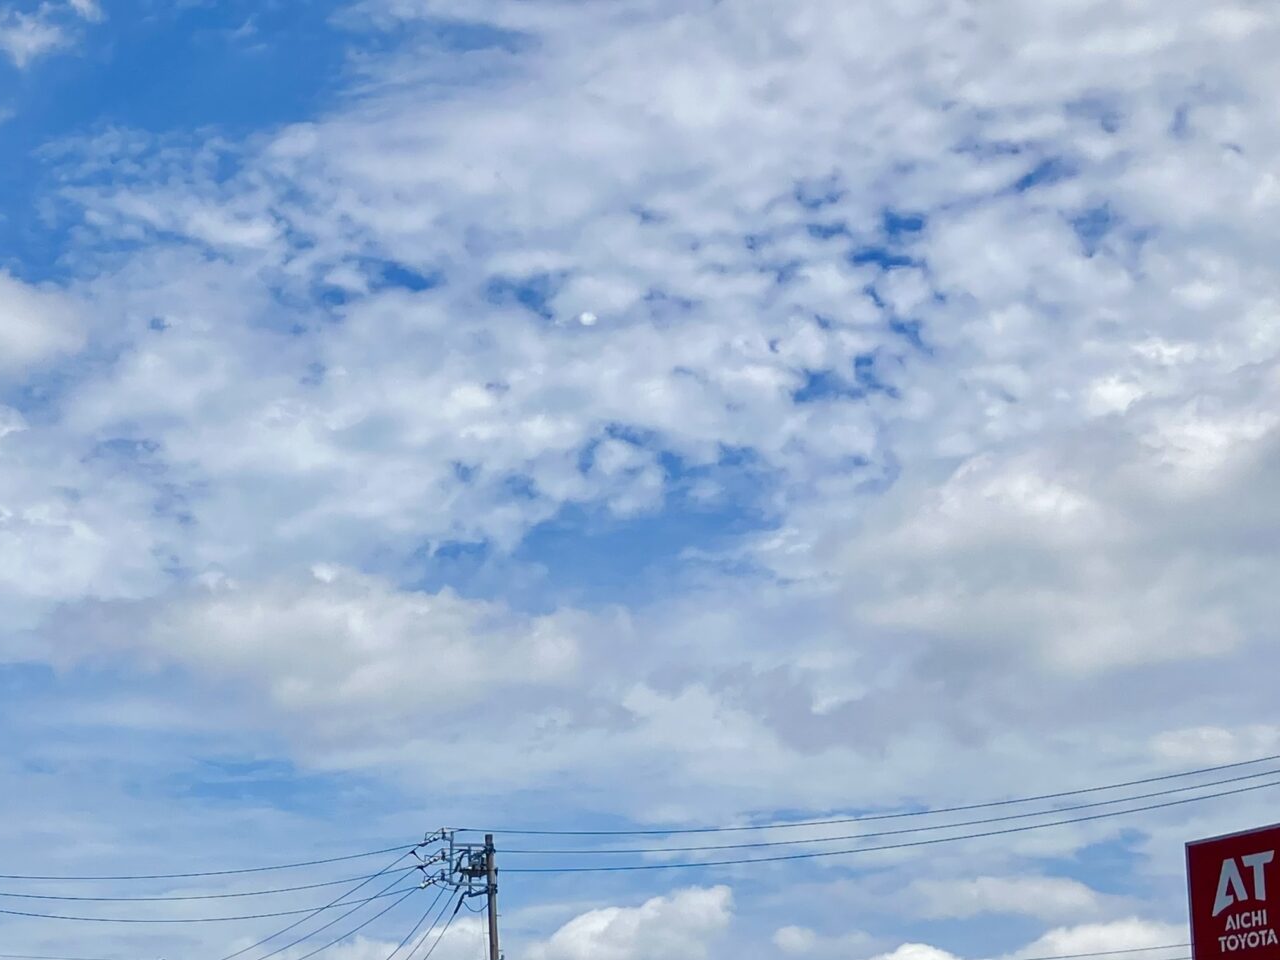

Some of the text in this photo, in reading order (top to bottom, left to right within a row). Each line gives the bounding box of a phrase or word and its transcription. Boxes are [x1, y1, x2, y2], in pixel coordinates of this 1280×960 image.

[1212, 850, 1275, 917] AT
[1225, 909, 1267, 931] AICHI
[1218, 928, 1278, 952] TOYOTA
